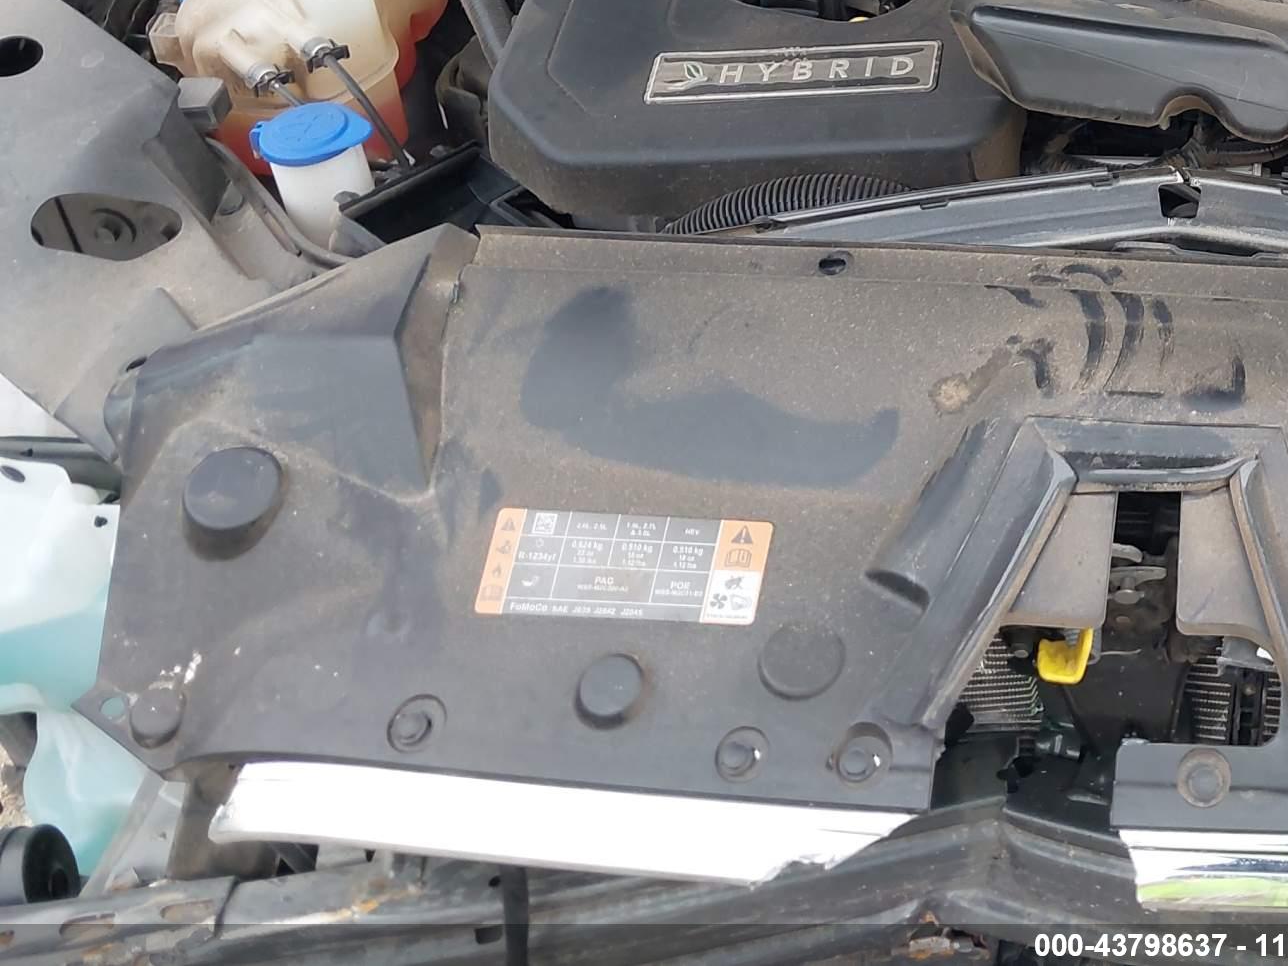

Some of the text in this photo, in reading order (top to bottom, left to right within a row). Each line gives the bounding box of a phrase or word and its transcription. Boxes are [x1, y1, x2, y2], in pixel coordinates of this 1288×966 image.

[719, 56, 915, 84] HYBRID
[593, 541, 603, 552] kg
[643, 544, 653, 553] kg
[694, 546, 704, 556] kg
[594, 576, 615, 585] PAG
[670, 580, 691, 589] POE
[510, 601, 548, 611] FoMoCo
